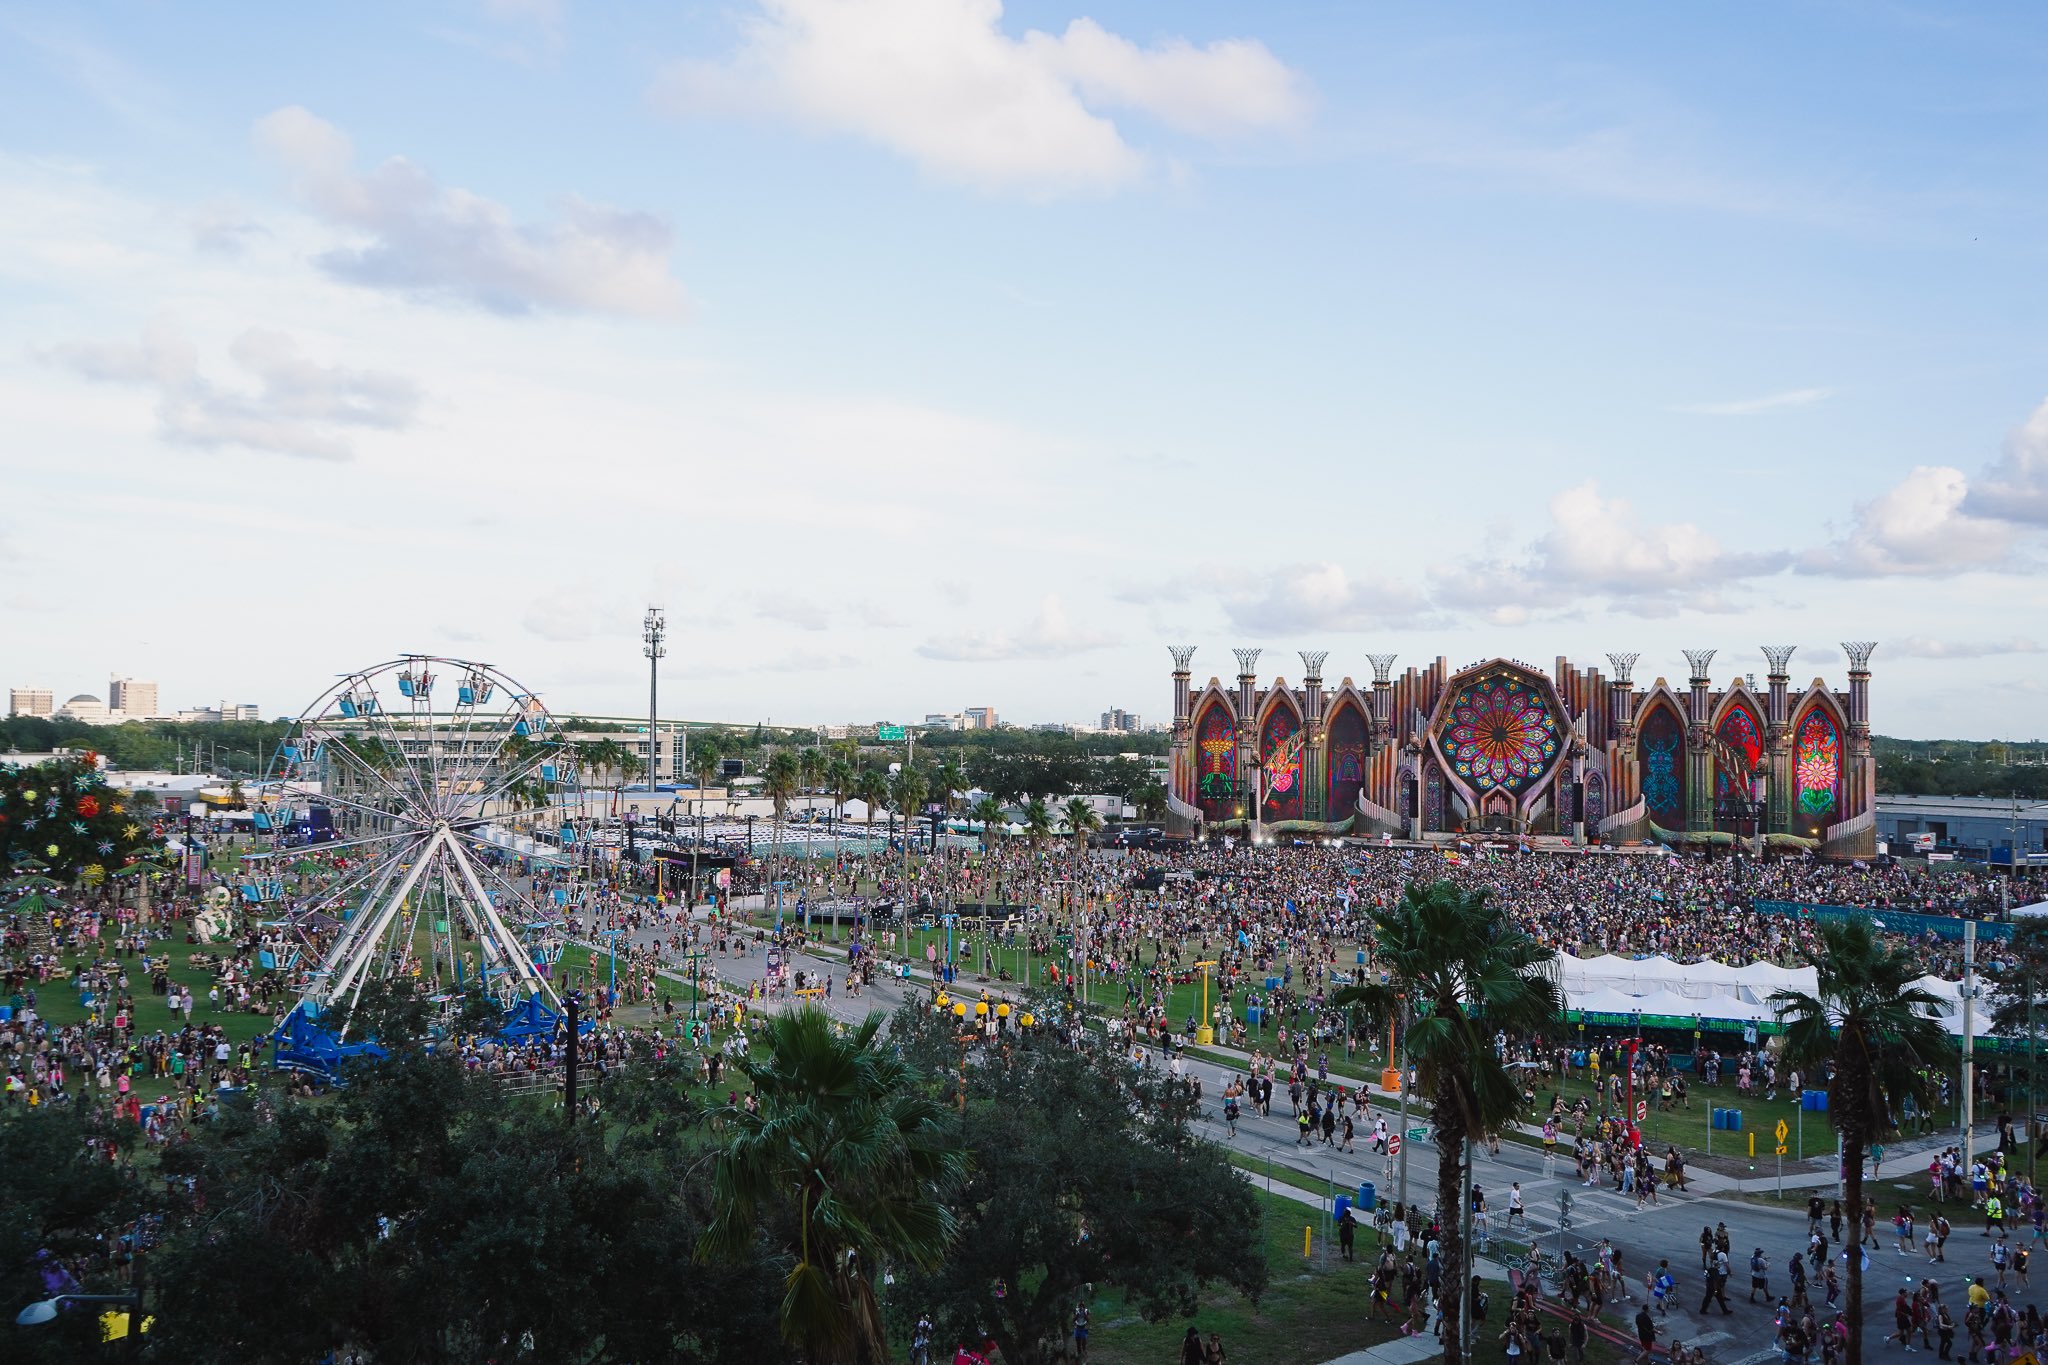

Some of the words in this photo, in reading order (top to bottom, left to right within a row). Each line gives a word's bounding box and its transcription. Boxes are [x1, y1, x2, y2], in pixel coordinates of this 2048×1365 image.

[1593, 1014, 1630, 1024] DRINKS
[1709, 1020, 1747, 1030] DRINKS
[1957, 1036, 1999, 1048] DINKS
